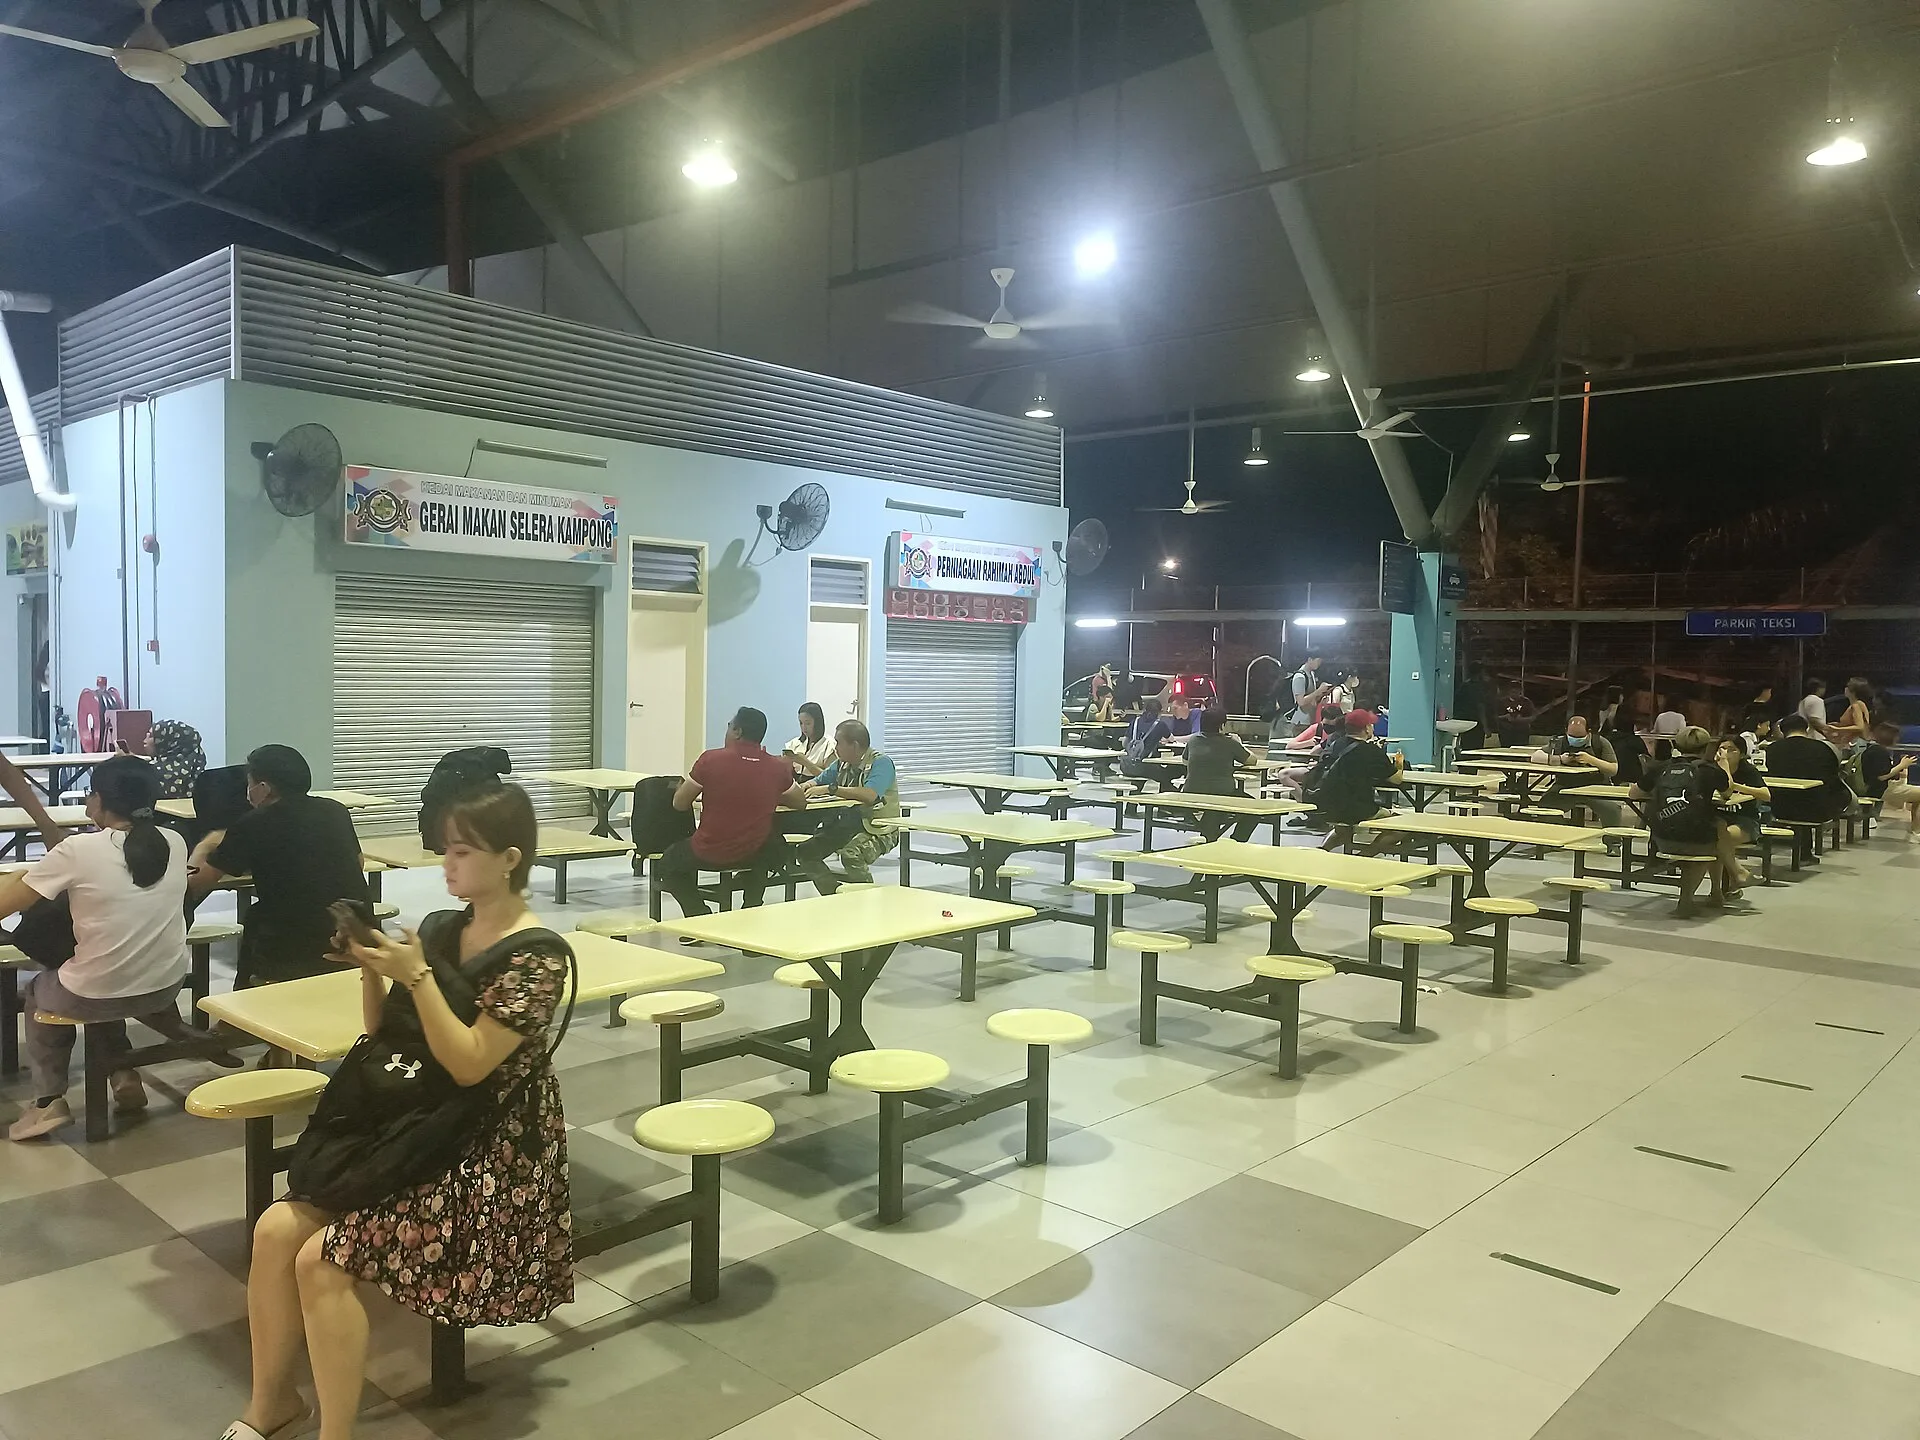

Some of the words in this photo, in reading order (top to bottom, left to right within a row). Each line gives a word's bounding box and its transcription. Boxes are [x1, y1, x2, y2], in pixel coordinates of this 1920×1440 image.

[421, 481, 453, 496] KEDAI
[455, 484, 505, 501] MAKANAN
[507, 490, 527, 504] DAN
[529, 494, 572, 509] MINUMAN
[420, 501, 458, 534] GERAI
[462, 505, 506, 538] MAKAN
[510, 510, 554, 543] SELERA
[557, 515, 613, 548] KAMPONG
[936, 555, 982, 580] PERNIAGAAN
[982, 560, 1013, 583] RAHIMAH
[1014, 563, 1035, 585] ABDUL
[1714, 618, 1757, 628] PARKIR
[1761, 618, 1796, 628] TEKSI
